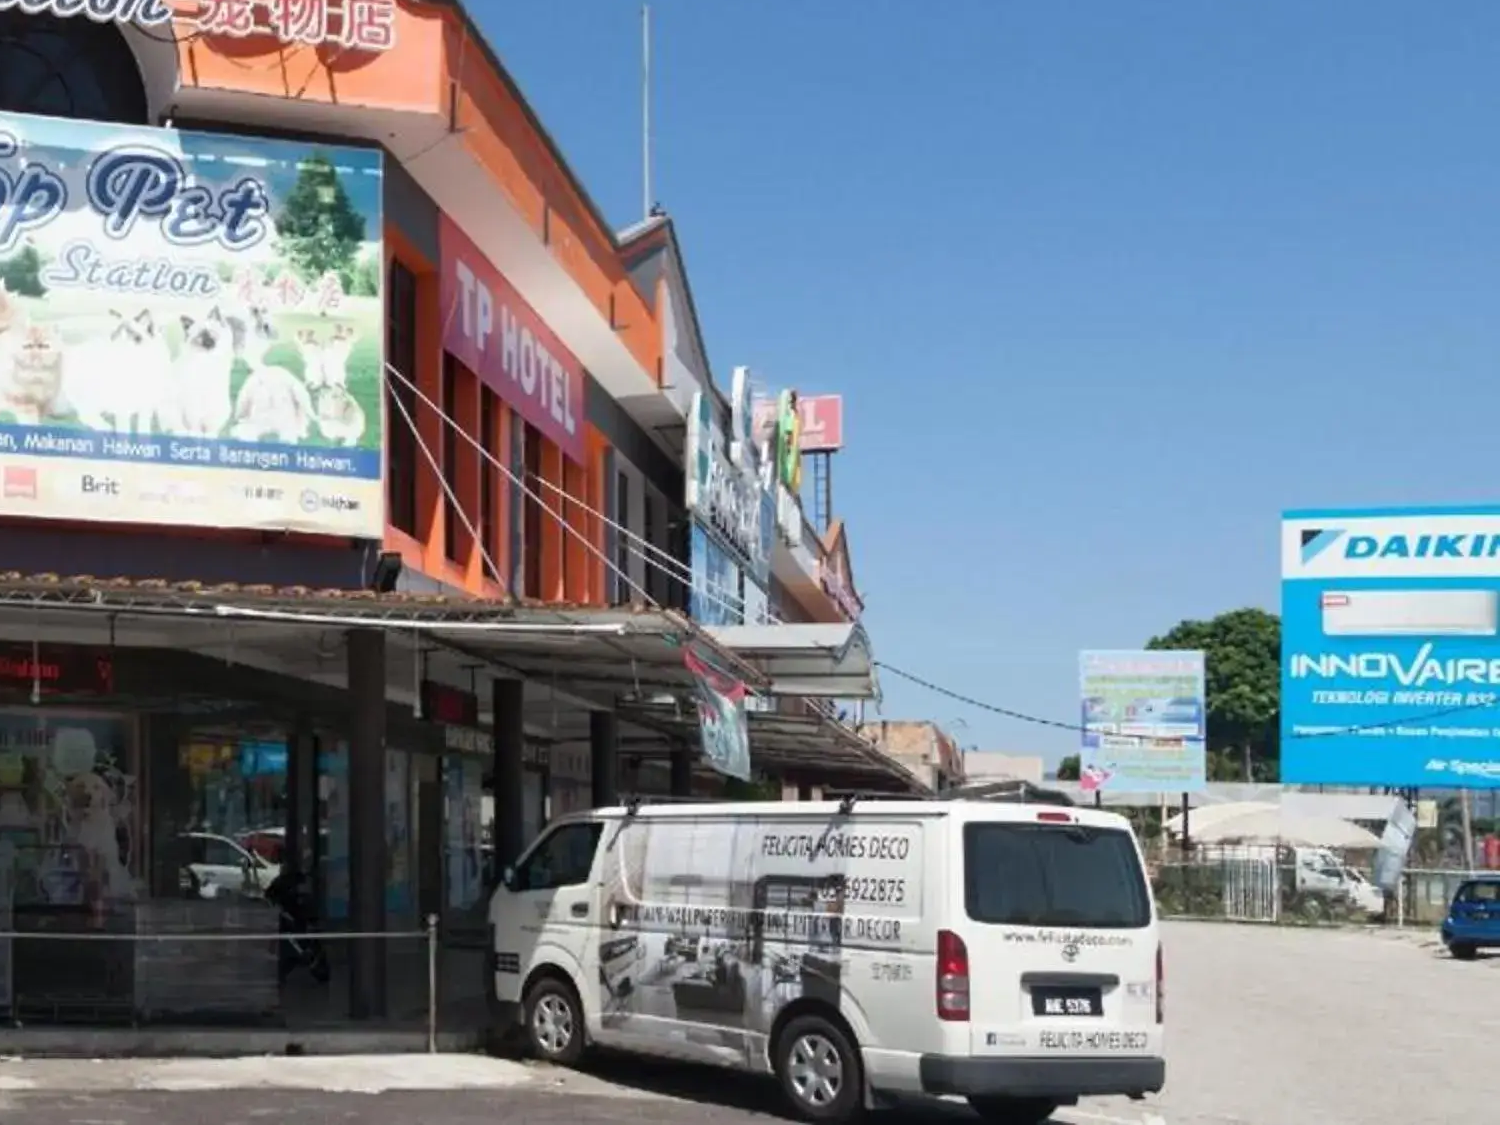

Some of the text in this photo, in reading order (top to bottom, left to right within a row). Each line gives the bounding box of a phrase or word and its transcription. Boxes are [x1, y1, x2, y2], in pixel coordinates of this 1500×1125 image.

[86, 144, 269, 251] Pet
[43, 240, 221, 297] Station
[455, 259, 576, 435] TP HOTEL
[24, 432, 94, 453] Makanan
[103, 437, 162, 458] Haiwan
[170, 442, 211, 462] Serta
[219, 446, 289, 469] Barangan
[81, 474, 120, 494] Brit
[1311, 690, 1390, 704] TEKNOLOGI
[1393, 691, 1463, 706] INVERTER
[762, 834, 813, 858] FELICITA
[869, 836, 909, 860] DECO
[857, 917, 901, 941] DECOR
